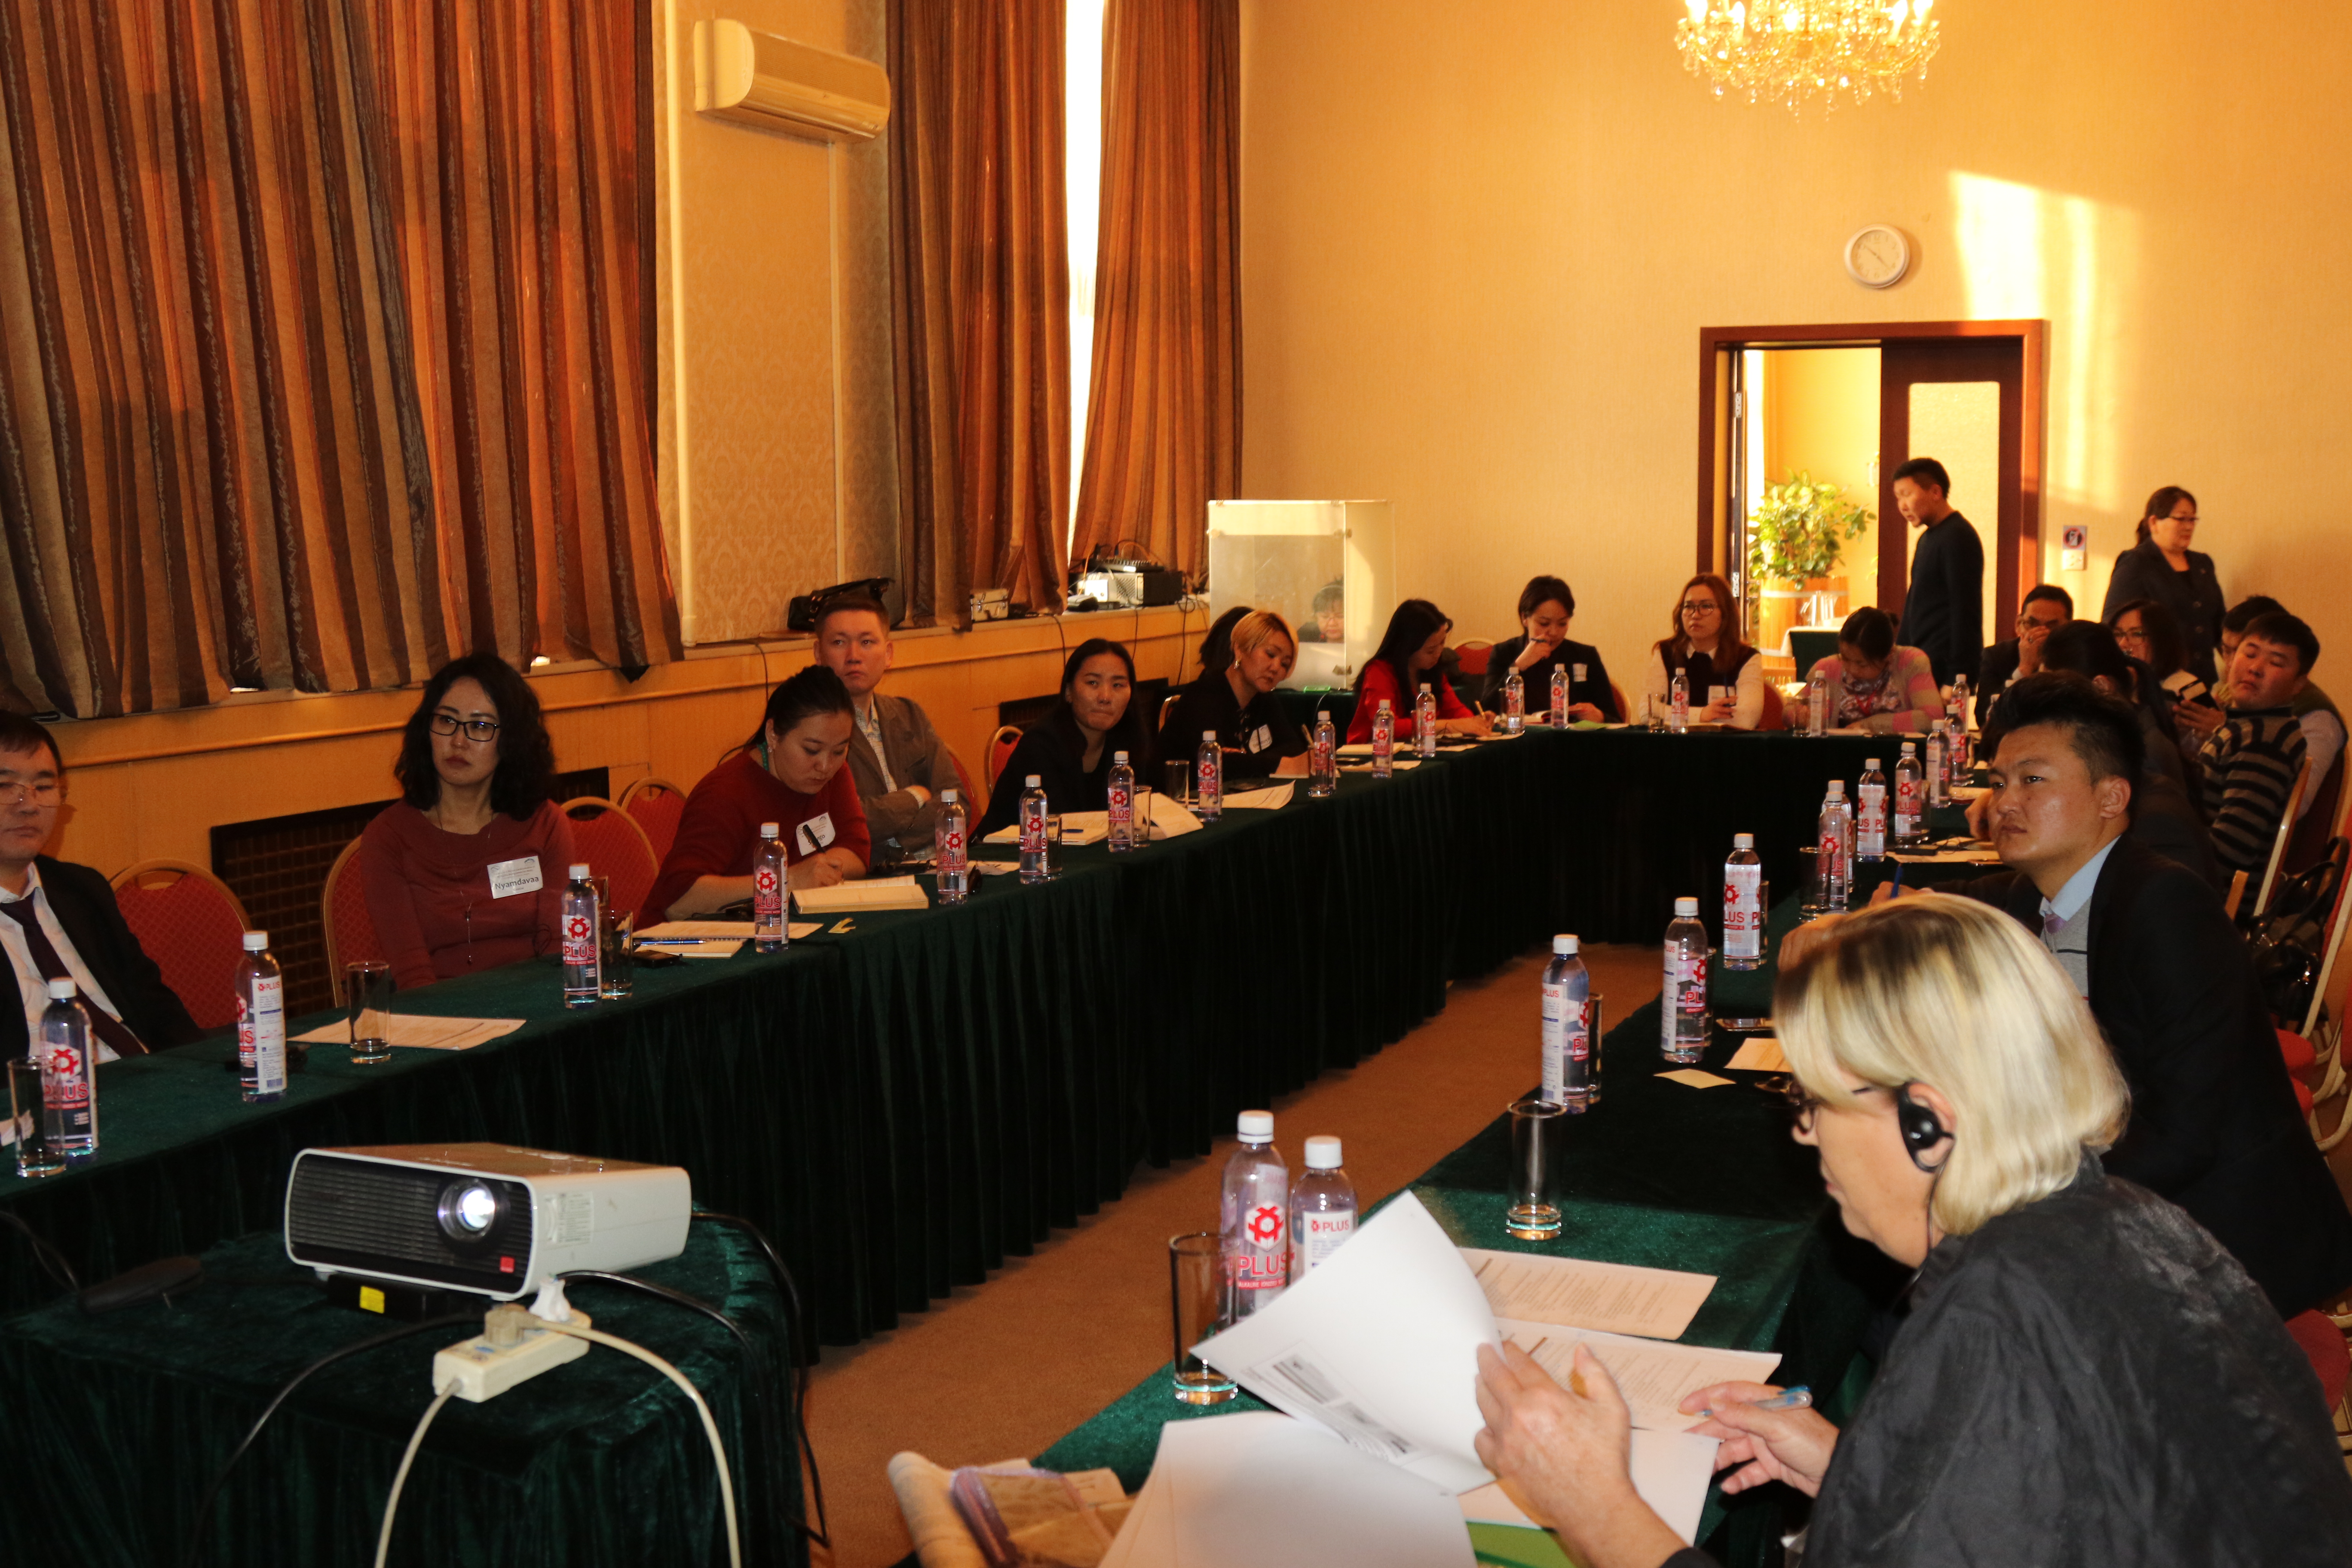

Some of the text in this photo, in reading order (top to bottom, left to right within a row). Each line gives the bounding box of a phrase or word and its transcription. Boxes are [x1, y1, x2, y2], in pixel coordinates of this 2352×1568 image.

[1109, 810, 1130, 818] PLUS
[1023, 837, 1047, 848] PLUS
[943, 854, 966, 865] PLUS
[495, 877, 539, 890] Nyamdavaa
[755, 897, 781, 908] PLUS
[564, 945, 597, 958] PLUS
[266, 981, 280, 990] PLUS
[1323, 1220, 1349, 1232] PLUS
[1238, 1251, 1288, 1277] PLUS
